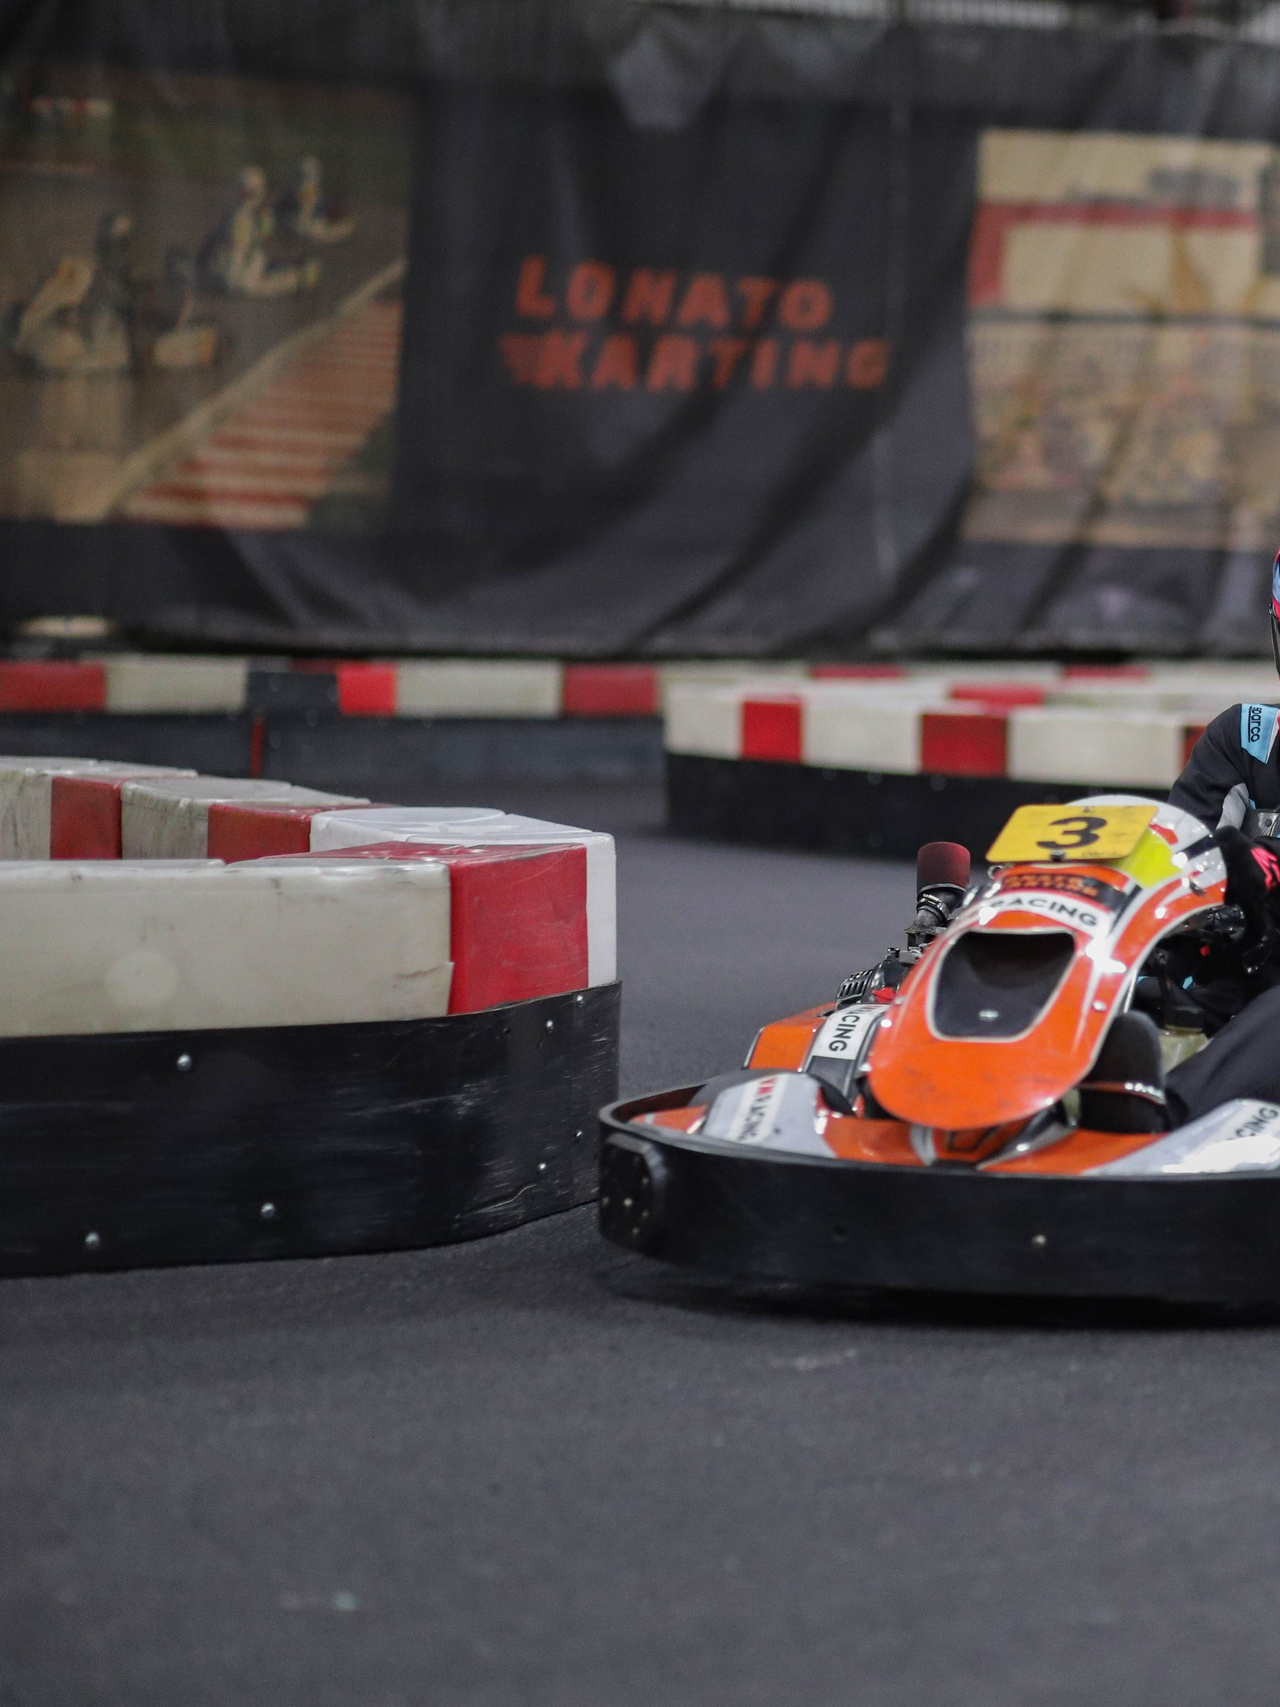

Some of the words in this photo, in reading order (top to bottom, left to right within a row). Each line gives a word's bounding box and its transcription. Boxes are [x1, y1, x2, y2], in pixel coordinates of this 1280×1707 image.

[516, 254, 836, 332] LONATO
[530, 330, 893, 391] KARTING
[1249, 706, 1263, 743] sparco
[1036, 815, 1108, 849] 3
